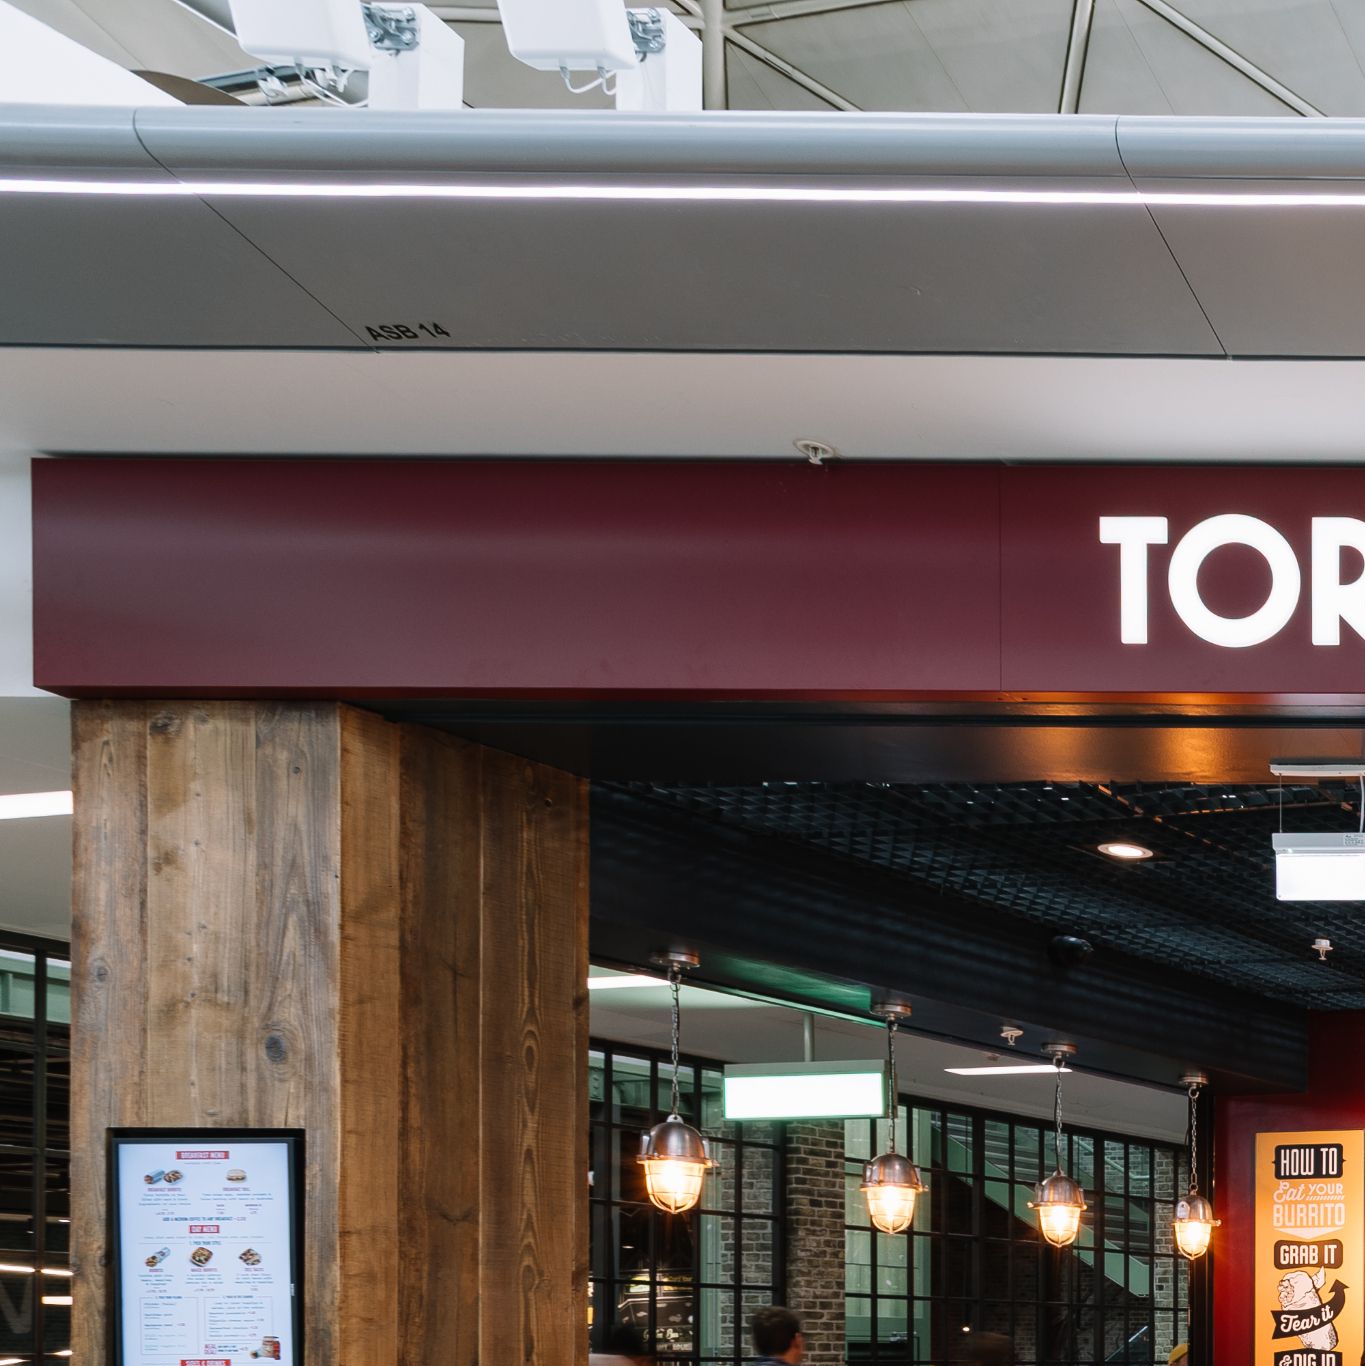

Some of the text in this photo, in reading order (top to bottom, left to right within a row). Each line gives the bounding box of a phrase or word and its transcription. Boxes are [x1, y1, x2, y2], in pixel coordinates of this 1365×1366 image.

[364, 321, 451, 342] ASB 14
[1280, 1147, 1338, 1176] HOW TO
[1273, 1181, 1343, 1203] Eat YOUR
[1272, 1203, 1345, 1227] BURRITO
[1279, 1244, 1337, 1265] GRAB IT
[1280, 1304, 1334, 1333] Tear it
